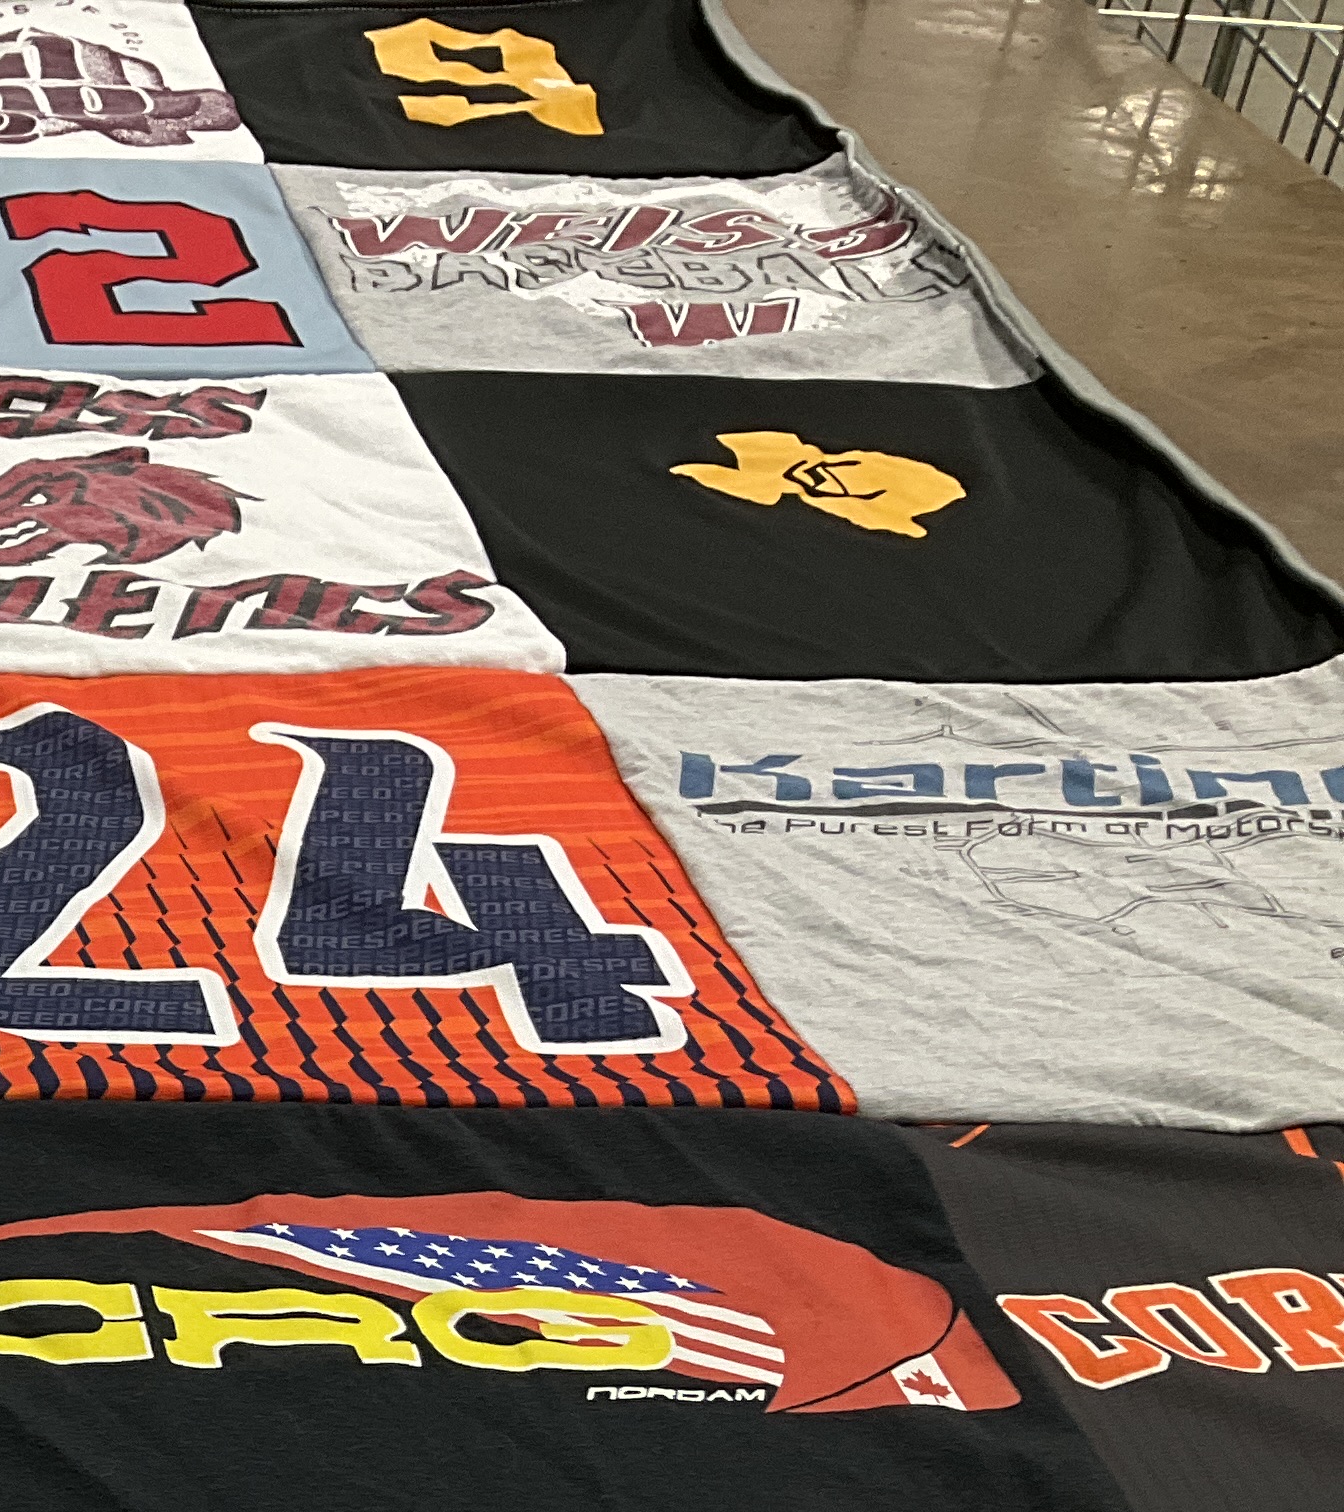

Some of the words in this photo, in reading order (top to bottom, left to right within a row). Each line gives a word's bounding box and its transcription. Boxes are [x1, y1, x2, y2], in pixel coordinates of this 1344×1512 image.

[312, 190, 916, 260] WEISS
[608, 296, 803, 348] W
[678, 749, 1344, 806] Kartin
[785, 818, 949, 837] Purest
[965, 817, 1087, 838] Form
[1105, 821, 1150, 837] of
[1166, 814, 1344, 841] Motors
[996, 1267, 1344, 1391] COR
[586, 1386, 767, 1402] NORDAM
